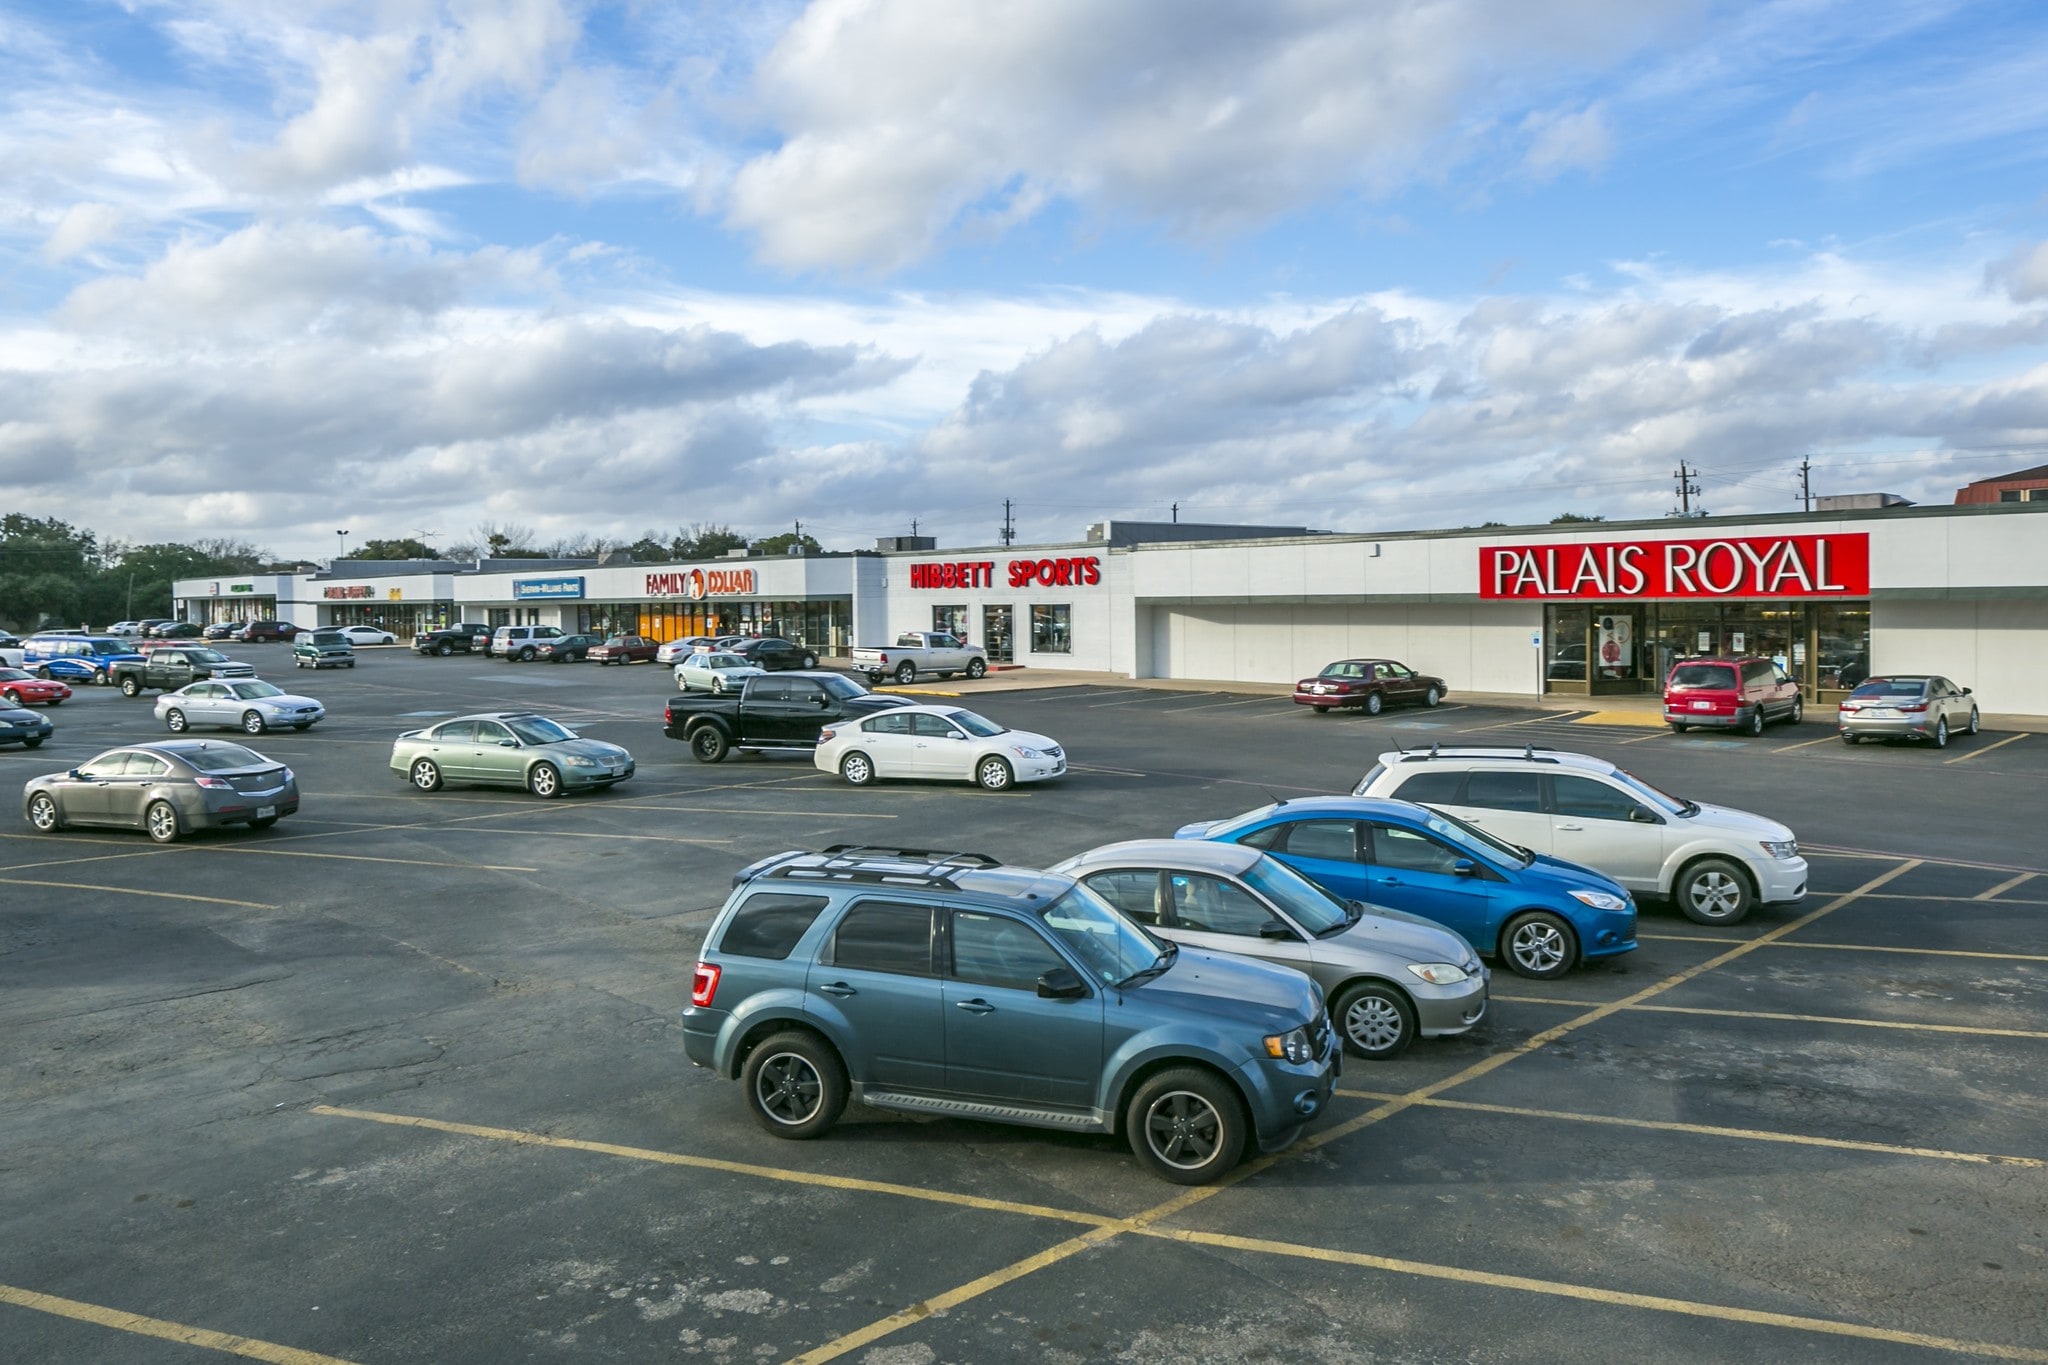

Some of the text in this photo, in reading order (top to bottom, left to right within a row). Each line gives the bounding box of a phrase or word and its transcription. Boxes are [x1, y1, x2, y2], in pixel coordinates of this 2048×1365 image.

[646, 569, 753, 594] FAMILY DOLLAR
[910, 556, 1099, 588] HIBBETT SPORTS
[1494, 538, 1845, 595] PALAIS ROYAL
